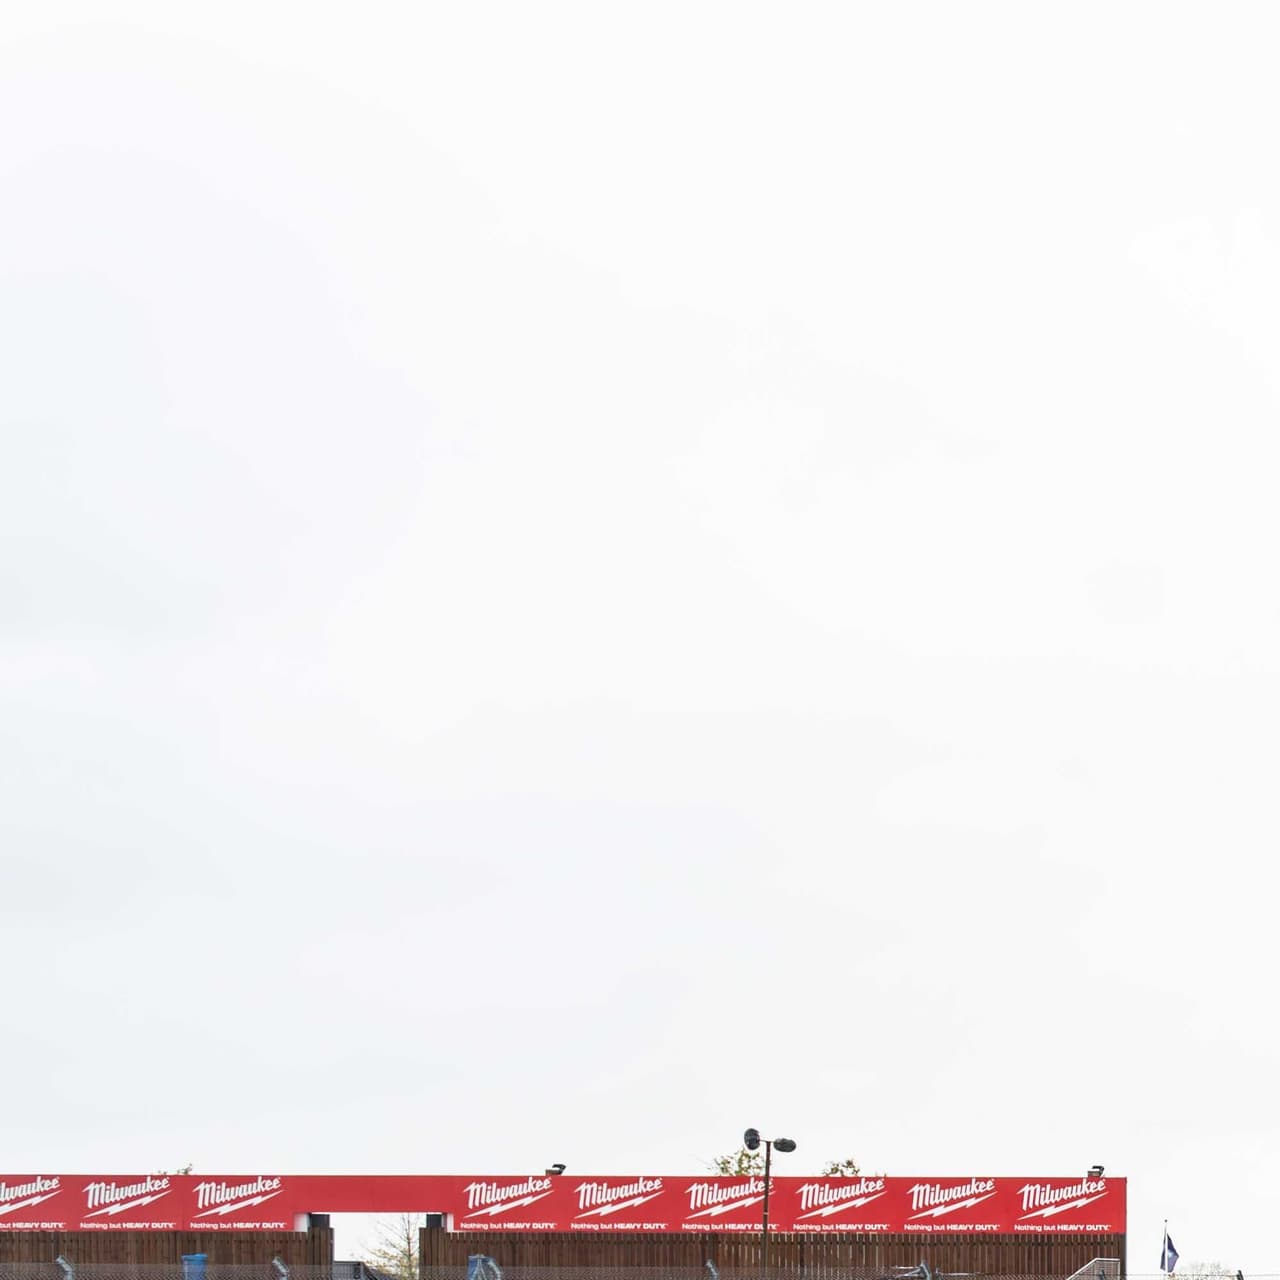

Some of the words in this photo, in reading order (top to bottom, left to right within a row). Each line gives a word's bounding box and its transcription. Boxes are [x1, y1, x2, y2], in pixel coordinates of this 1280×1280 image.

[82, 1176, 170, 1208] Milwaukee
[192, 1176, 281, 1209] Milwaukee
[463, 1176, 552, 1209] Milwaukee
[574, 1176, 663, 1210] Milwaukee
[795, 1177, 885, 1210] Milwaukee
[906, 1178, 996, 1210] Milwaukee
[1017, 1178, 1106, 1211] Milwaukee
[80, 1222, 108, 1230] Nothing
[190, 1222, 218, 1230] Nothing
[460, 1223, 488, 1231] Nothing
[571, 1223, 599, 1231] Nothing
[682, 1223, 710, 1231] Nothing
[793, 1224, 821, 1232] Nothing
[904, 1224, 932, 1232] Nothing
[1015, 1224, 1042, 1232] Nothing
